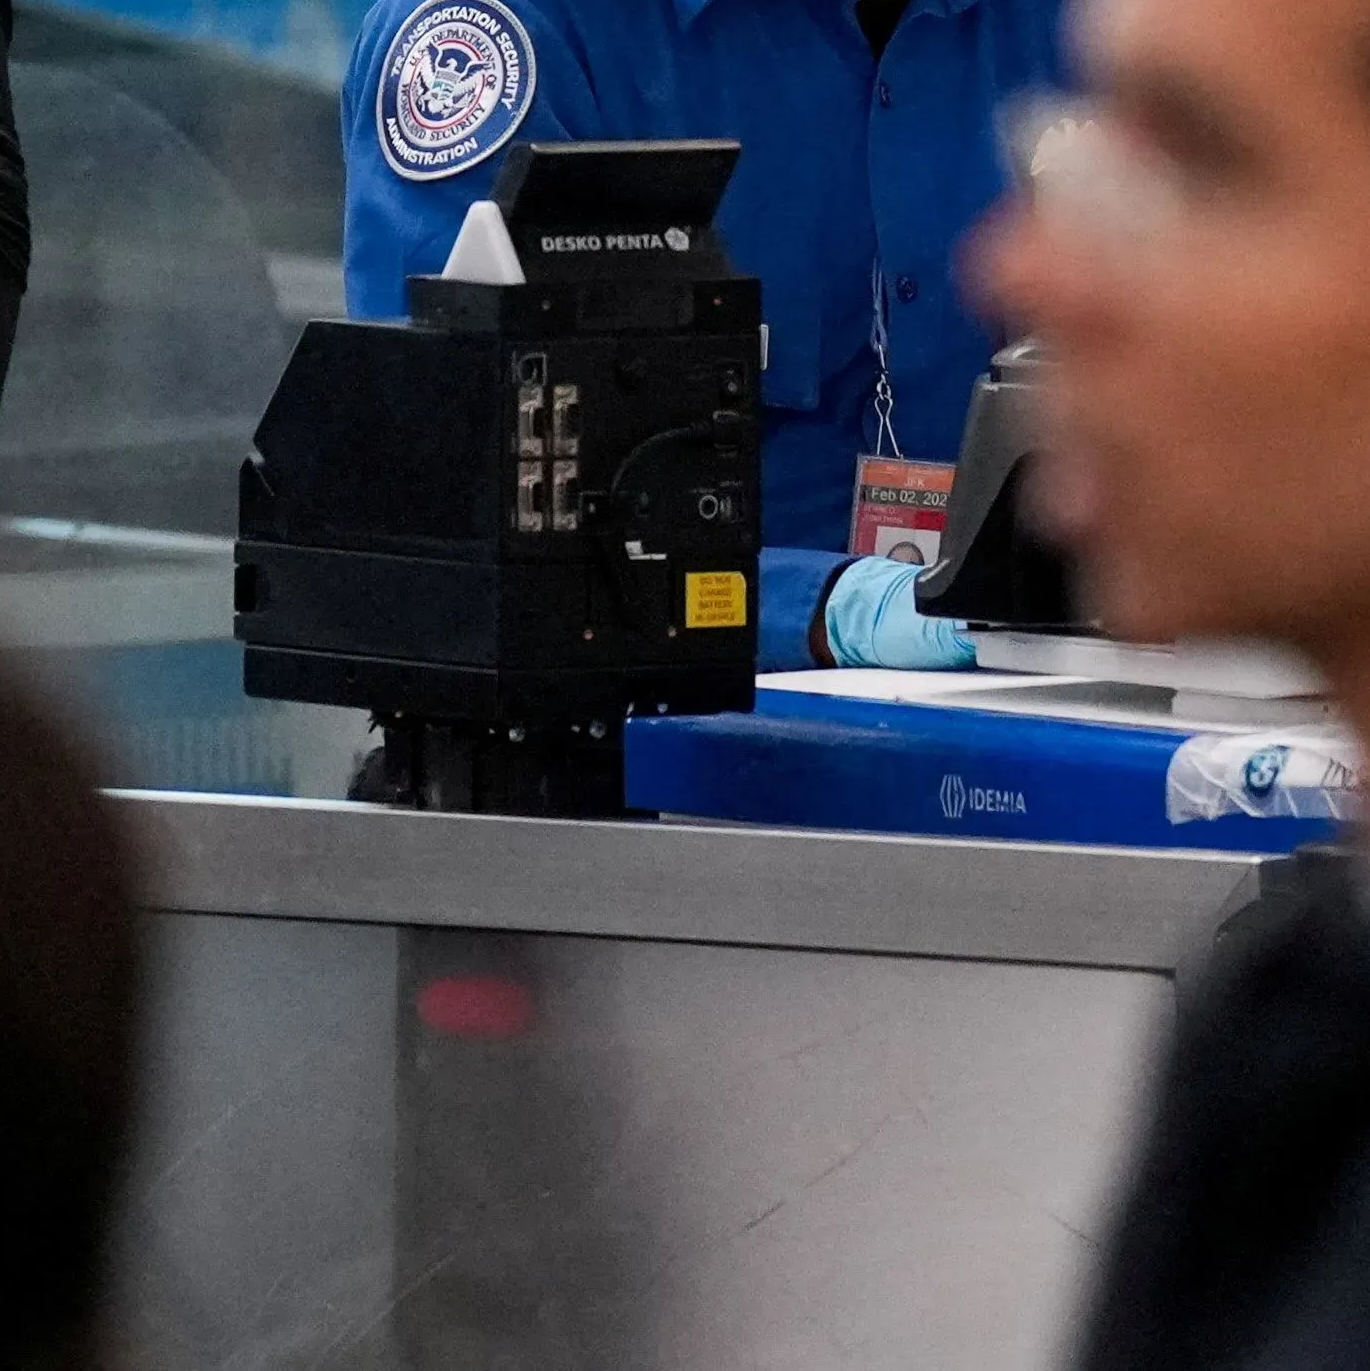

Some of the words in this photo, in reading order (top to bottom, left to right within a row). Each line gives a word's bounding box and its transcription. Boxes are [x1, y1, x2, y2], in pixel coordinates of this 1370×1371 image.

[390, 5, 501, 78] TRANSPORTATION
[495, 31, 520, 110] SECURITY
[432, 28, 496, 68] DEPARTMENT
[386, 117, 479, 166] ADMINISTRATION
[429, 102, 486, 142] SECURITY
[540, 234, 602, 254] DESKO
[606, 233, 664, 251] PENTA
[871, 487, 897, 502] Feb
[923, 492, 950, 507] 202
[968, 786, 1028, 815] IDEMIA
